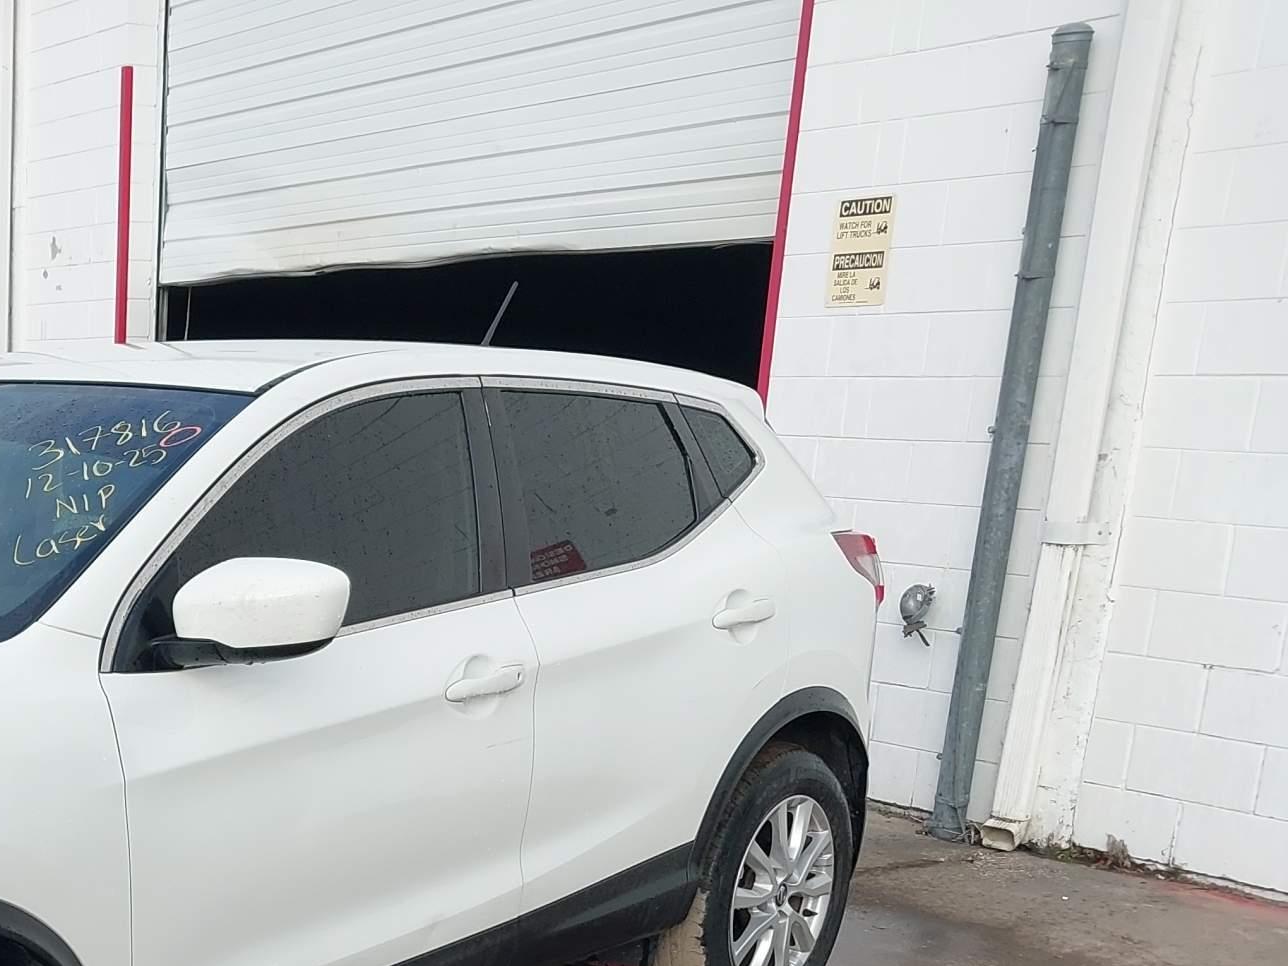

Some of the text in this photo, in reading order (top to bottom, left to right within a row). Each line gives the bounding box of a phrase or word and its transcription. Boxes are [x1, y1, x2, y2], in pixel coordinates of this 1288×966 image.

[841, 197, 891, 216] CAUTION
[836, 229, 872, 240] LIFT TRUCKS
[839, 220, 872, 231] WATCH FOR
[833, 252, 884, 269] PRECAUCION
[28, 410, 181, 470] 317816
[24, 444, 168, 499] 12-10-25
